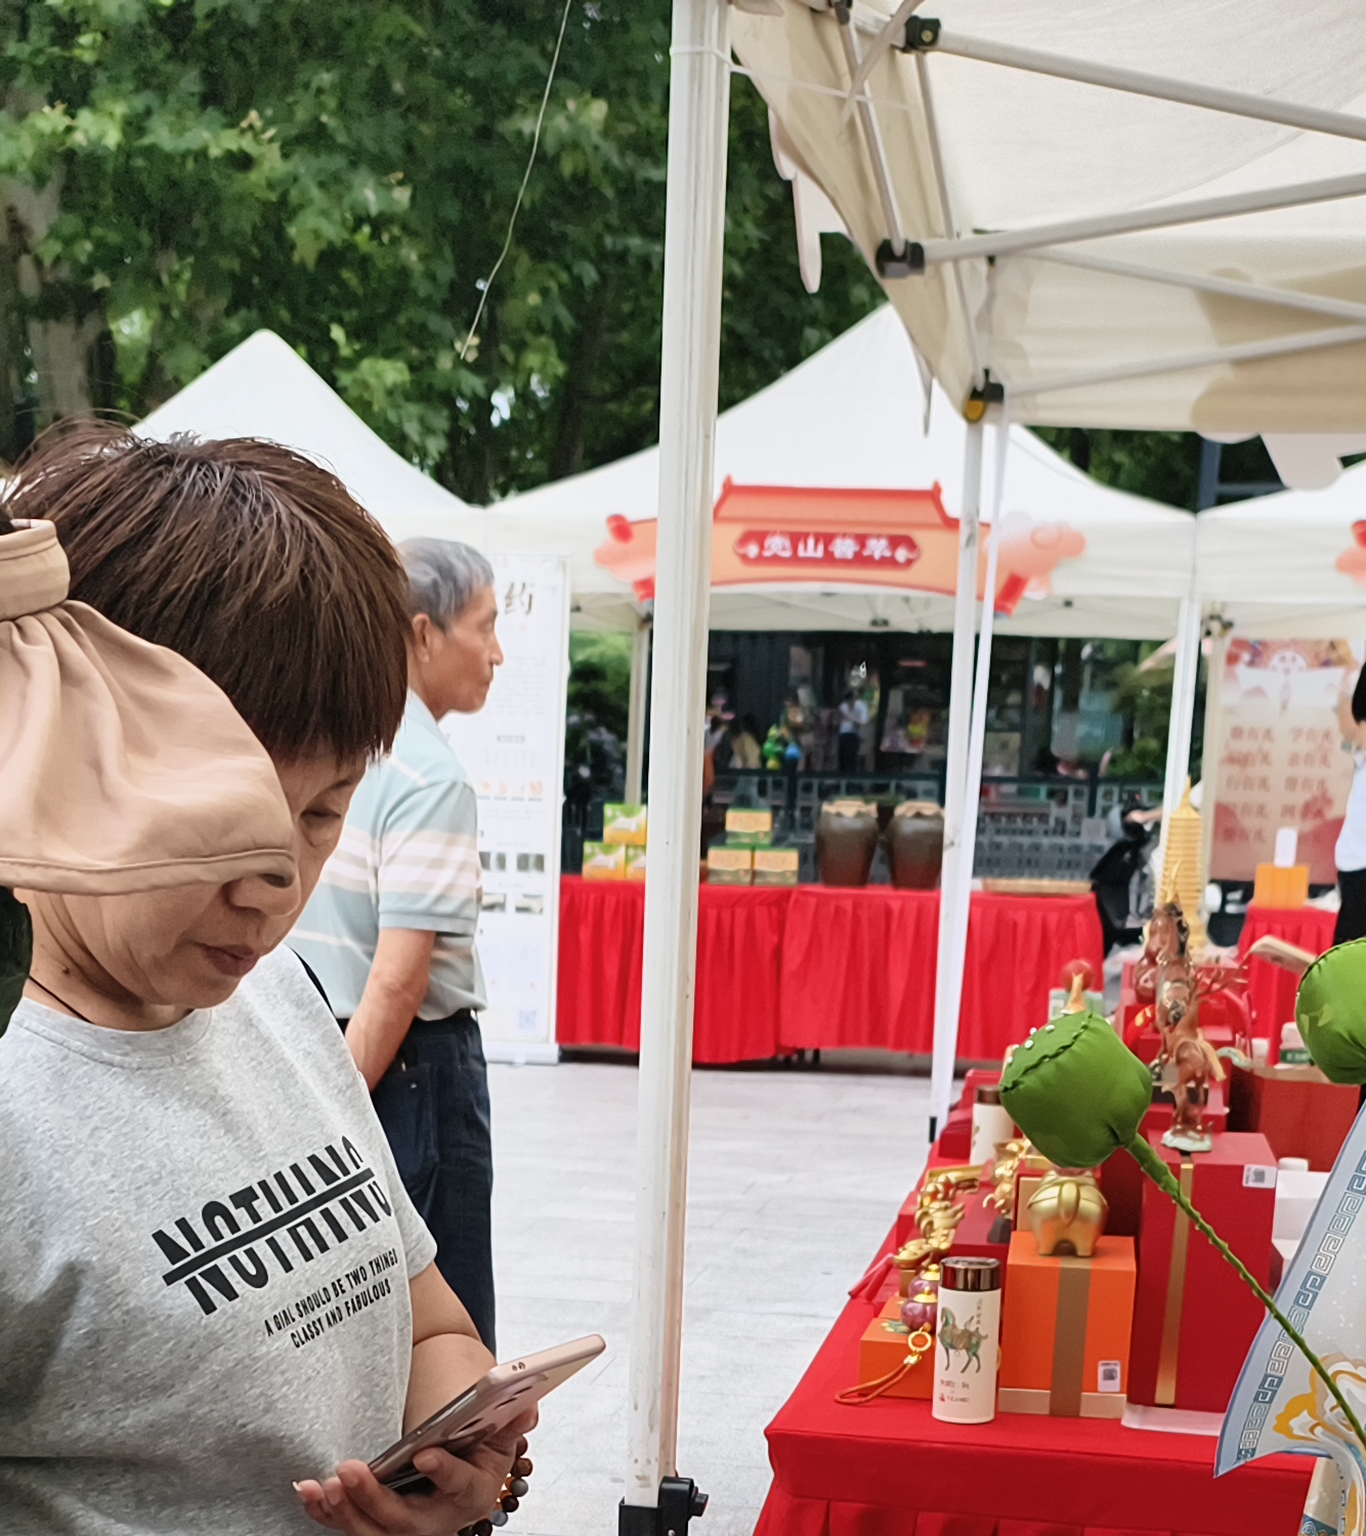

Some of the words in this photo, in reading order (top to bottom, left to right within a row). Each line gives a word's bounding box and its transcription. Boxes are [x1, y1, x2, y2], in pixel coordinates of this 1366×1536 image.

[264, 1319, 274, 1337] A
[273, 1307, 296, 1331] GIRL
[295, 1287, 332, 1318] SHOULD
[331, 1278, 346, 1298] BE
[345, 1266, 368, 1289] TWO
[368, 1248, 399, 1277] THINGS
[290, 1317, 325, 1349] CLASSY
[325, 1306, 343, 1328] AND
[344, 1278, 391, 1317] FABULOUS
